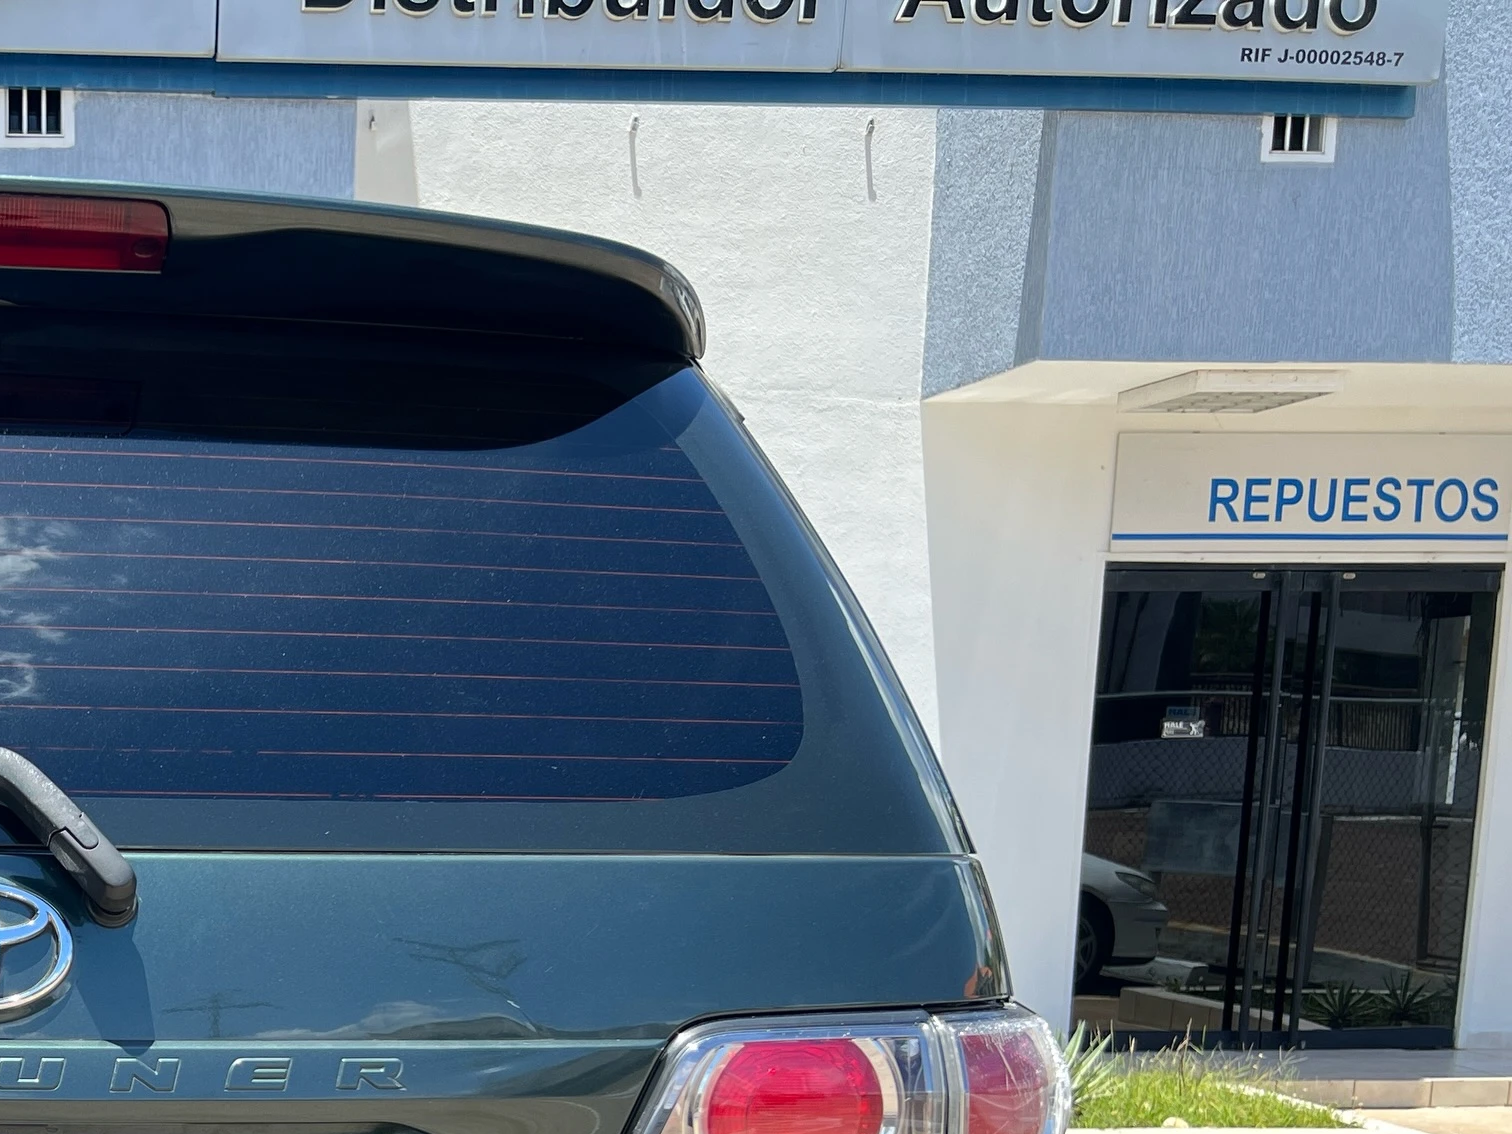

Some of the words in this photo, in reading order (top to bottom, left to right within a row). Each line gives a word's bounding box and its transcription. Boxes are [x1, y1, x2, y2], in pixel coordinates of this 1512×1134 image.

[895, 0, 1378, 34] ozado
[1240, 47, 1273, 63] RIF
[1277, 48, 1405, 67] J-00002548-7
[1208, 477, 1499, 522] REPUESTOS
